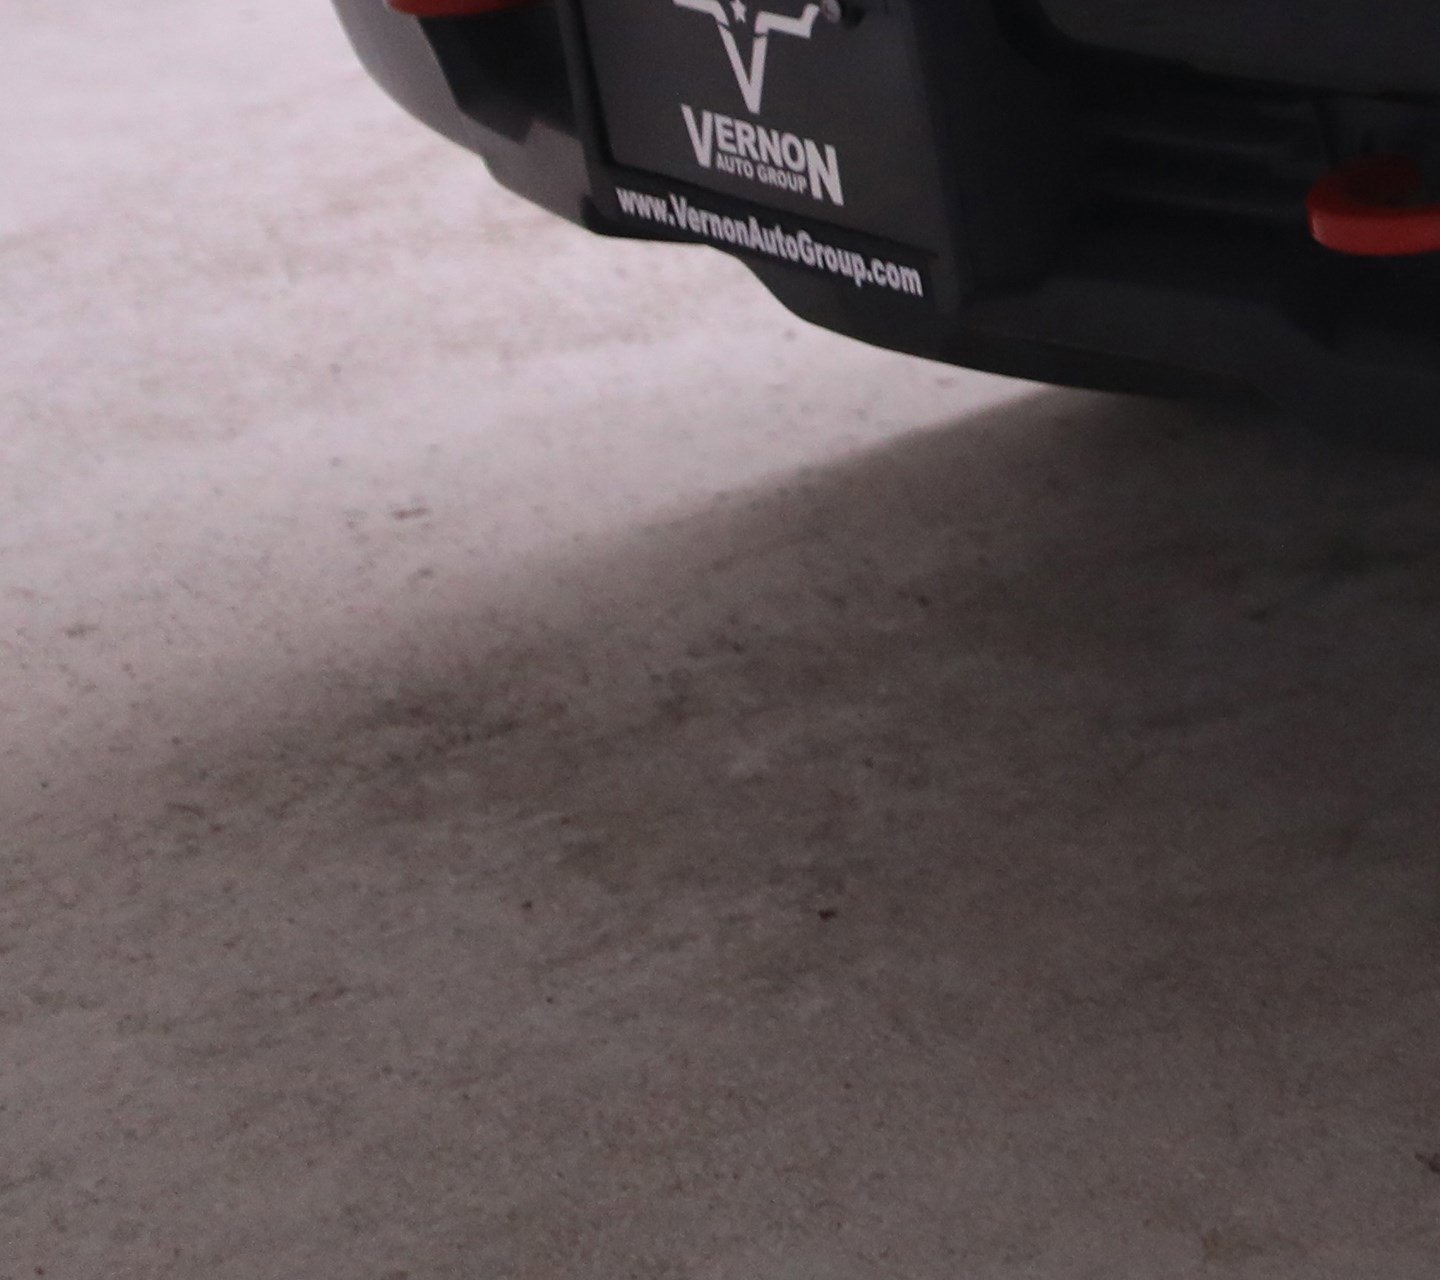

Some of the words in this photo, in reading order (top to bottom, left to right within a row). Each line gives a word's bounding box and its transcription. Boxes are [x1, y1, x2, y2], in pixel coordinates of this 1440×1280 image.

[680, 102, 845, 207] VERNON
[715, 153, 754, 180] AUTO
[757, 165, 809, 195] GROUP
[616, 186, 924, 298] www.VernonAutoGroup.com
